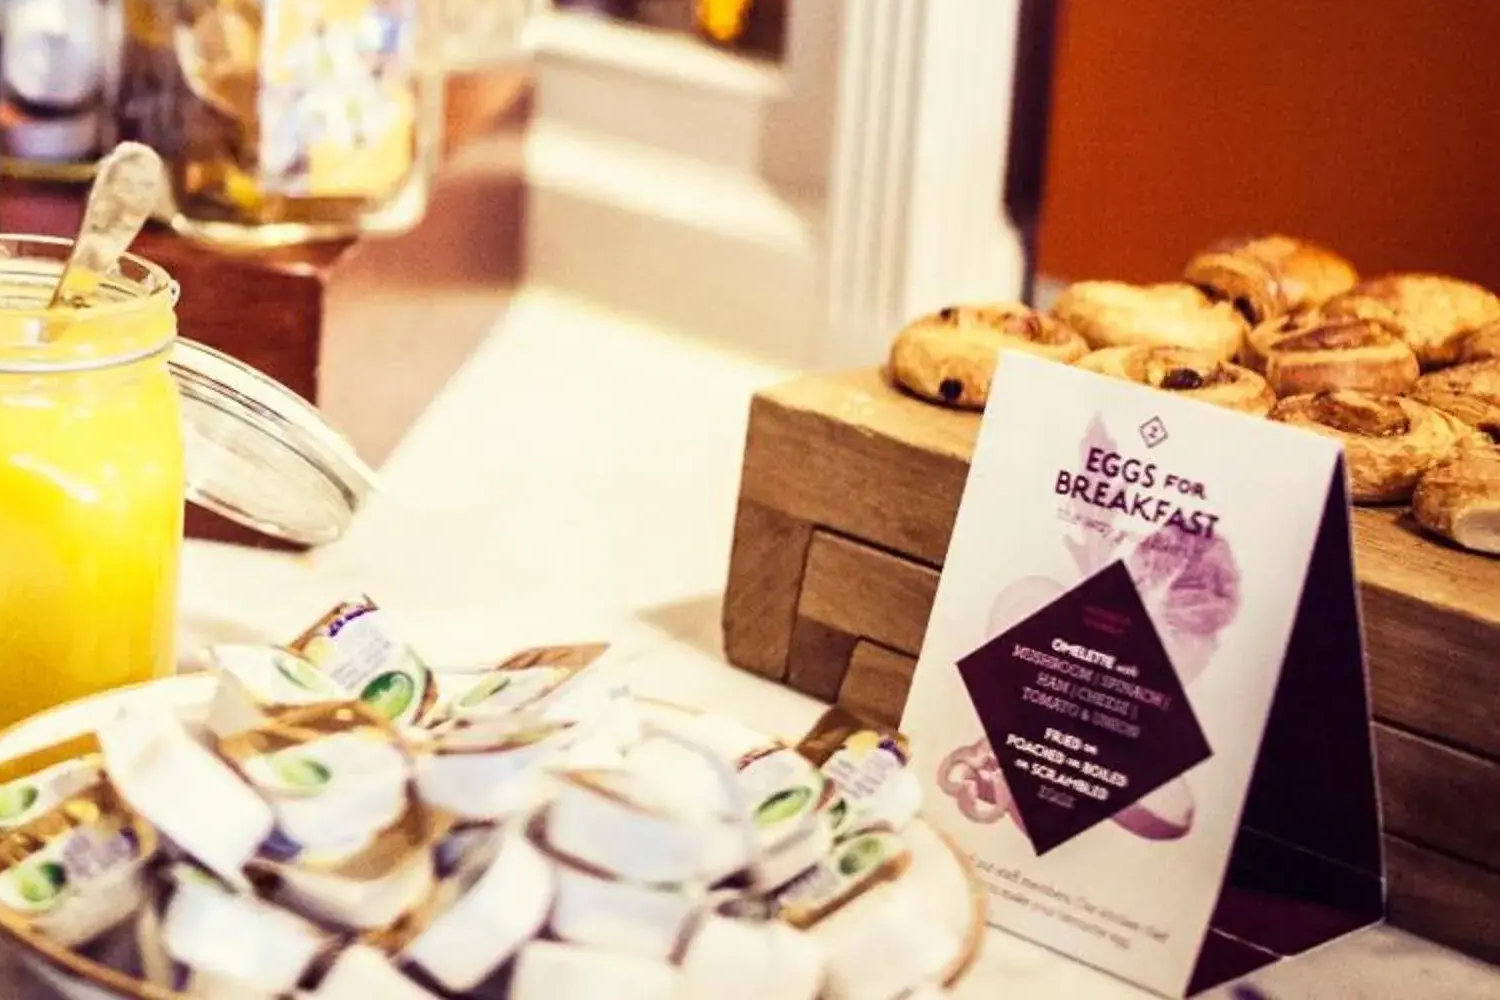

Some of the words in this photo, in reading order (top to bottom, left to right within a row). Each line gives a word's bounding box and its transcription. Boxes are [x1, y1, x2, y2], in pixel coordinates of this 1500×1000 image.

[1085, 446, 1157, 489] EGGS
[1164, 473, 1207, 500] FOR
[1055, 470, 1220, 539] BREAKFAST
[1006, 733, 1066, 764] POACHED
[1044, 727, 1083, 751] FRIED
[1030, 763, 1109, 800] SCRAMBLED
